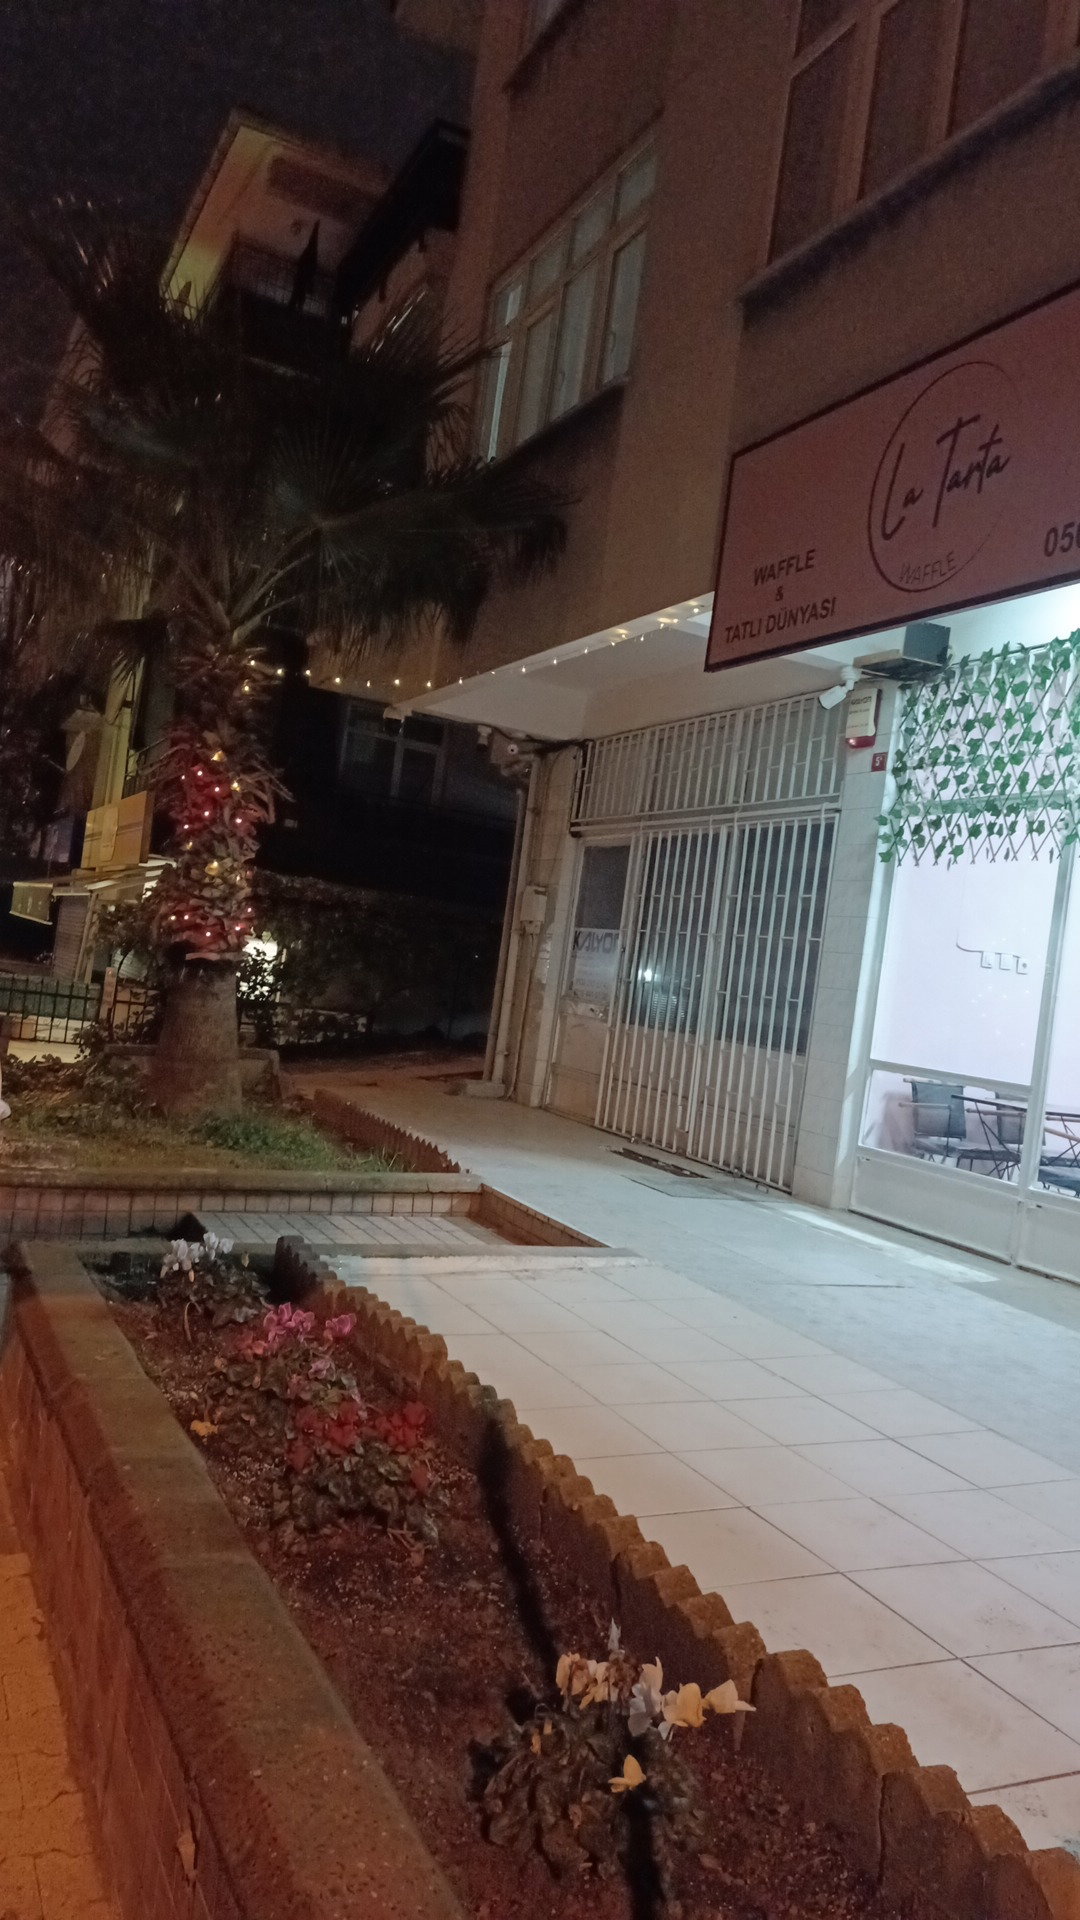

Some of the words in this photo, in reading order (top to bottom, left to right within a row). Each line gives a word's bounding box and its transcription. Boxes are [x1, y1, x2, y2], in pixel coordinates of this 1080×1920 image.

[881, 442, 924, 541] La
[932, 414, 1010, 528] Tarta
[1044, 521, 1080, 557] 05
[754, 549, 816, 586] WAFFLE
[899, 551, 956, 584] WAFFLE
[775, 586, 784, 601] &
[725, 618, 762, 643] TATLI
[765, 597, 837, 634] DÜNYASI
